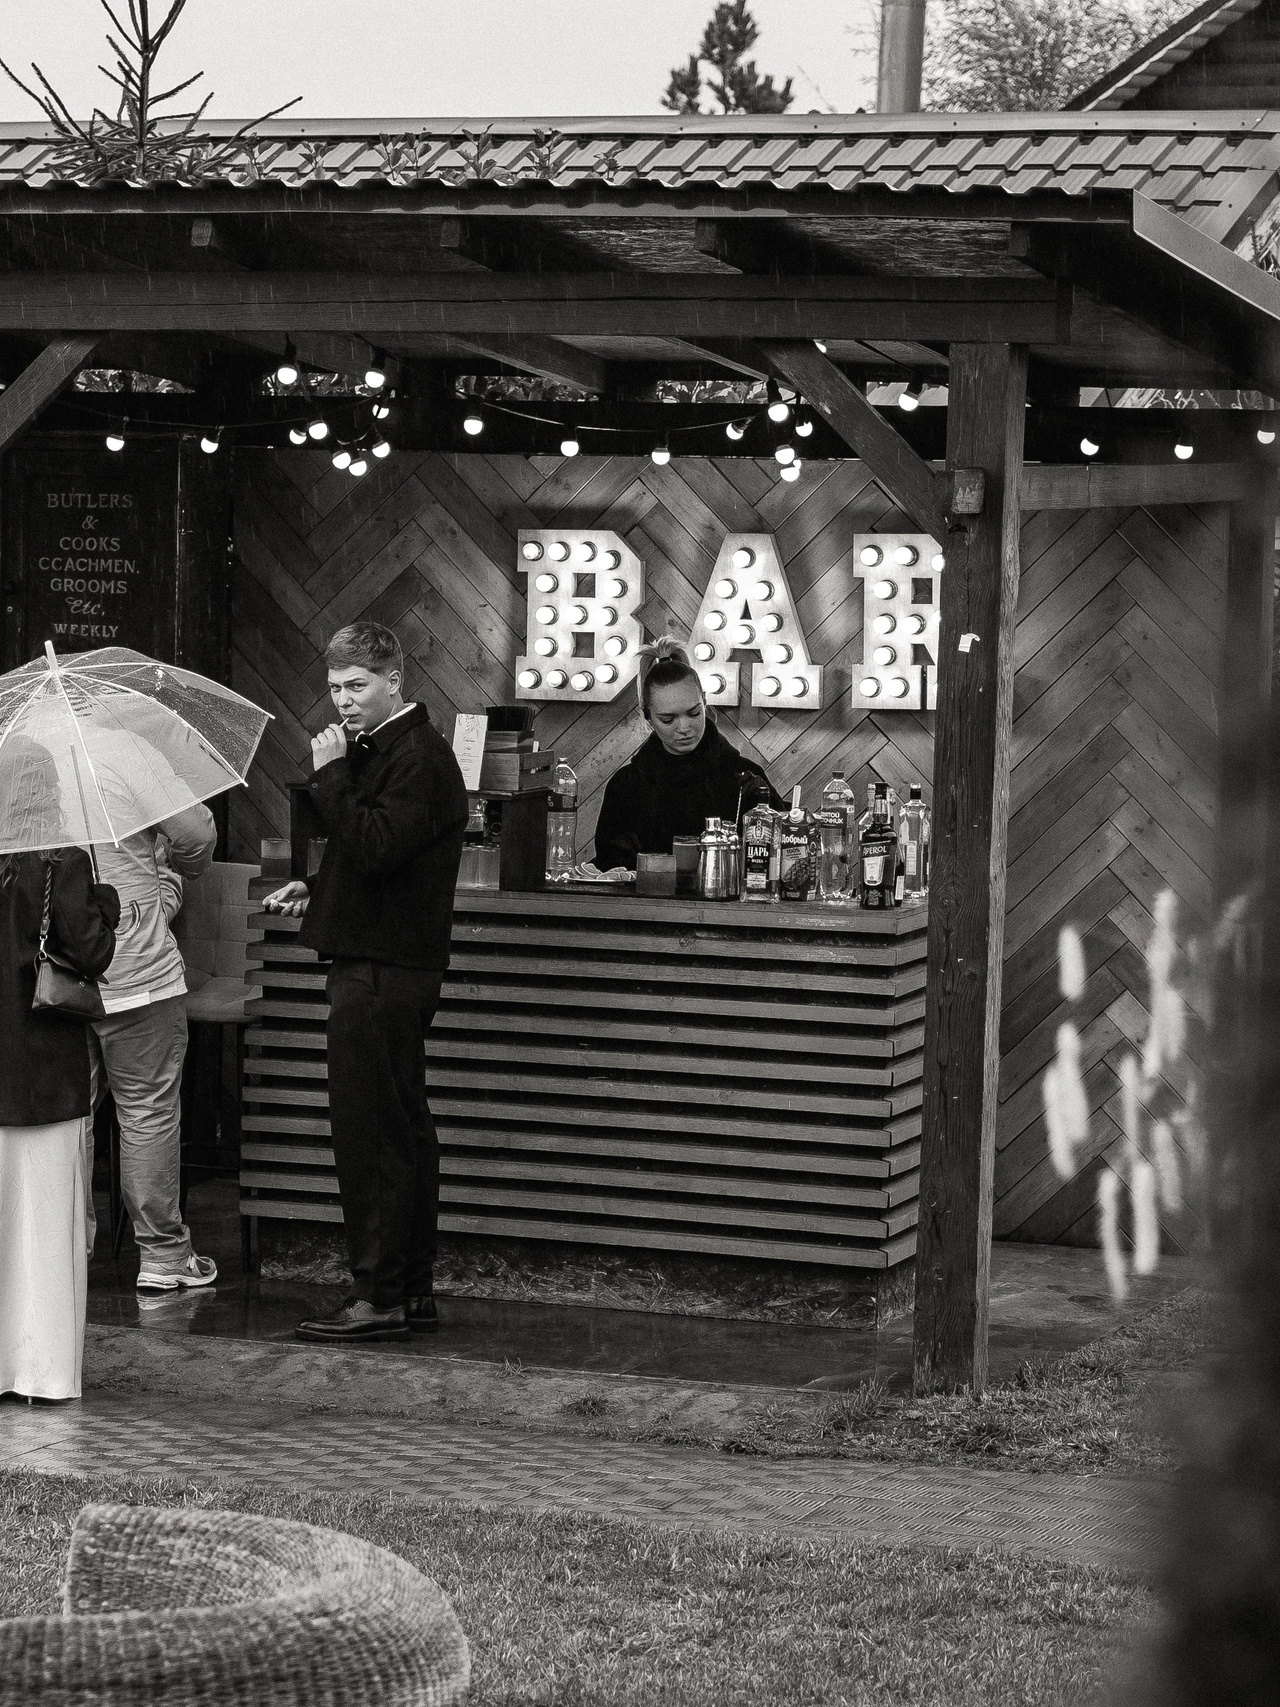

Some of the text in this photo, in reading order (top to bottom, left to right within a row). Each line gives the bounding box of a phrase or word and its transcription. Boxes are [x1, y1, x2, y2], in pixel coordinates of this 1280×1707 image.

[47, 493, 133, 509] BUTLERS
[81, 515, 99, 530] &
[59, 536, 121, 552] COOKS
[50, 578, 128, 594] GROOMS
[515, 528, 942, 710] BAR
[53, 623, 119, 638] WEEKLY
[781, 833, 808, 845] Добрый
[747, 846, 769, 858] ЦАРЬ
